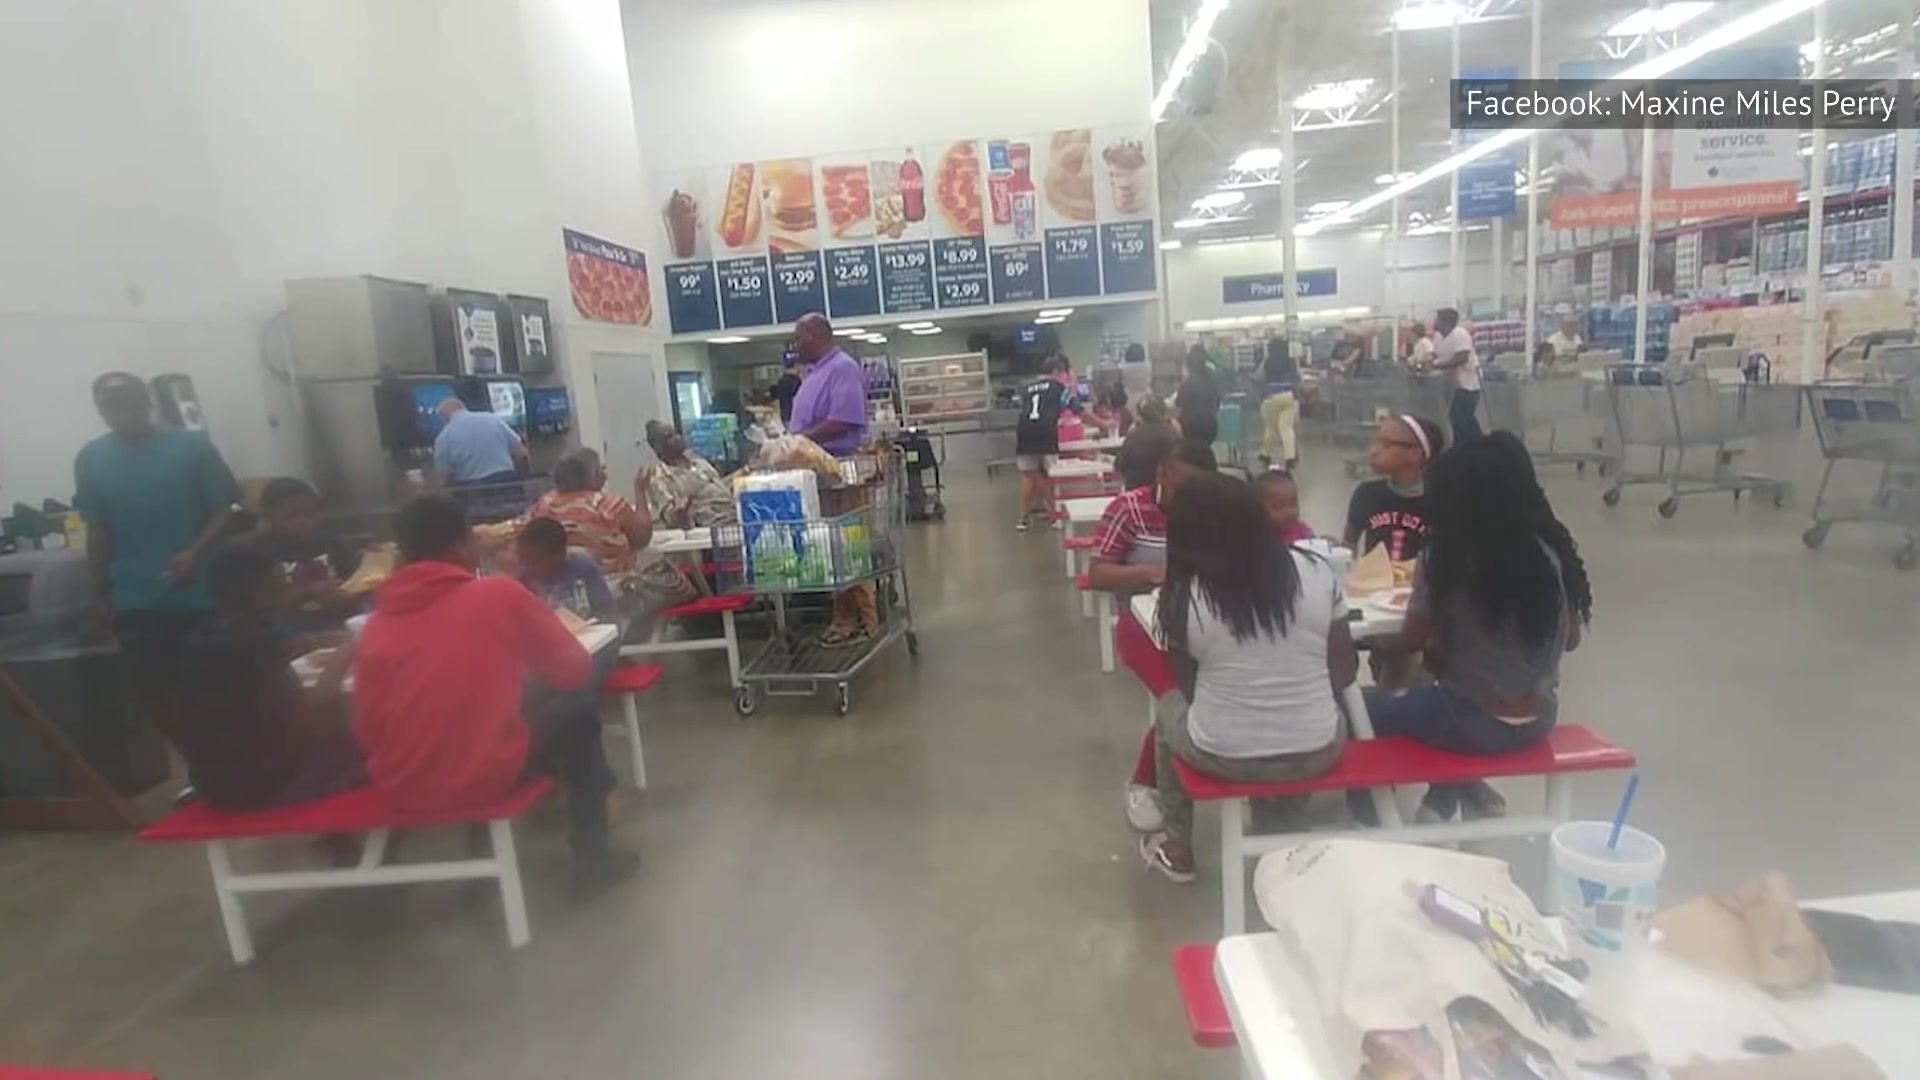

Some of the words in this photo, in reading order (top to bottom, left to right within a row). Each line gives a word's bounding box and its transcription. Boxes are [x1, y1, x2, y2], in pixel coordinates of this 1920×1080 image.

[1056, 237, 1088, 254] $1.79
[1112, 239, 1144, 254] $1.59
[885, 252, 926, 269] $13.99
[943, 247, 978, 264] $8.99
[780, 269, 816, 285] $2.99
[834, 263, 869, 279] $2.49
[727, 275, 761, 291] $1.50
[945, 281, 981, 298] $2.99
[1250, 281, 1311, 296] Pharmy
[1029, 393, 1040, 420] 1
